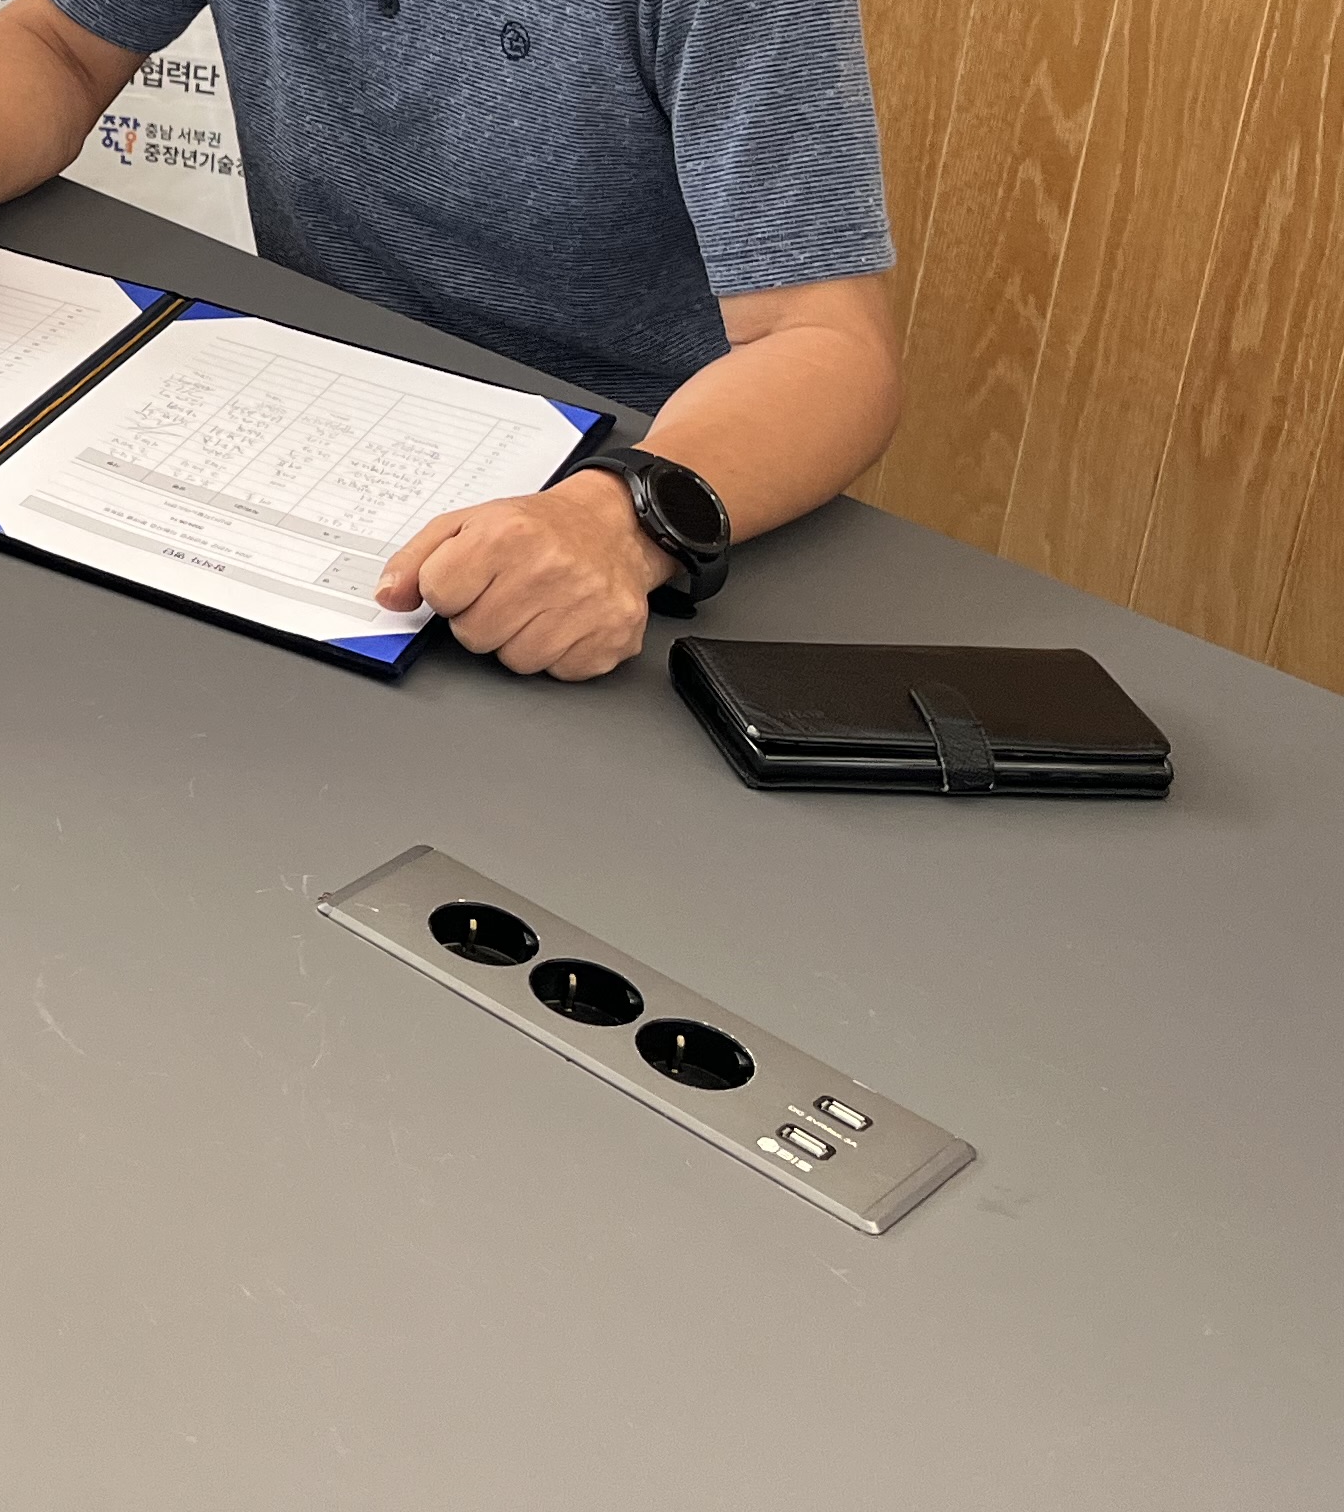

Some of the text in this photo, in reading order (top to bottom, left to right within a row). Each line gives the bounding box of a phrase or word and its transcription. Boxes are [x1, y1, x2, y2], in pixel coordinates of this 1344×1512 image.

[129, 57, 221, 96] 협력단
[145, 122, 222, 149] 충남 서부권
